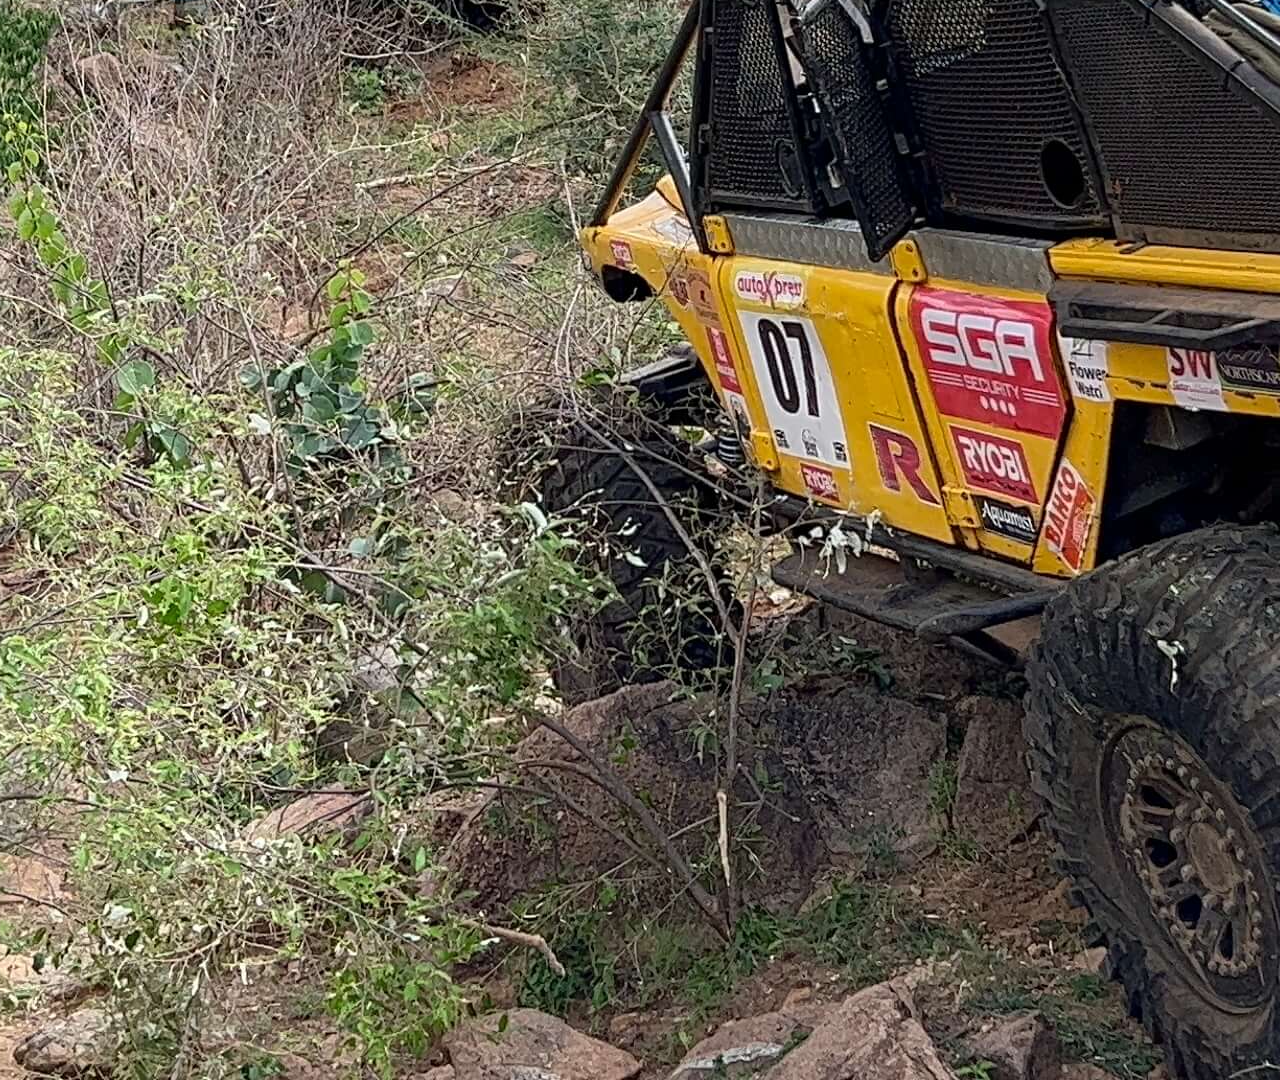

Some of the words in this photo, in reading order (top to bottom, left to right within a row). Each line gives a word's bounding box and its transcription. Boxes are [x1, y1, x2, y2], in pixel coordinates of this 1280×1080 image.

[758, 318, 820, 417] 07
[921, 307, 1045, 382] SGA
[963, 374, 1019, 400] SECURITY
[869, 424, 941, 505] R
[958, 435, 1029, 483] RYOBI
[1045, 466, 1076, 548] BAHCO
